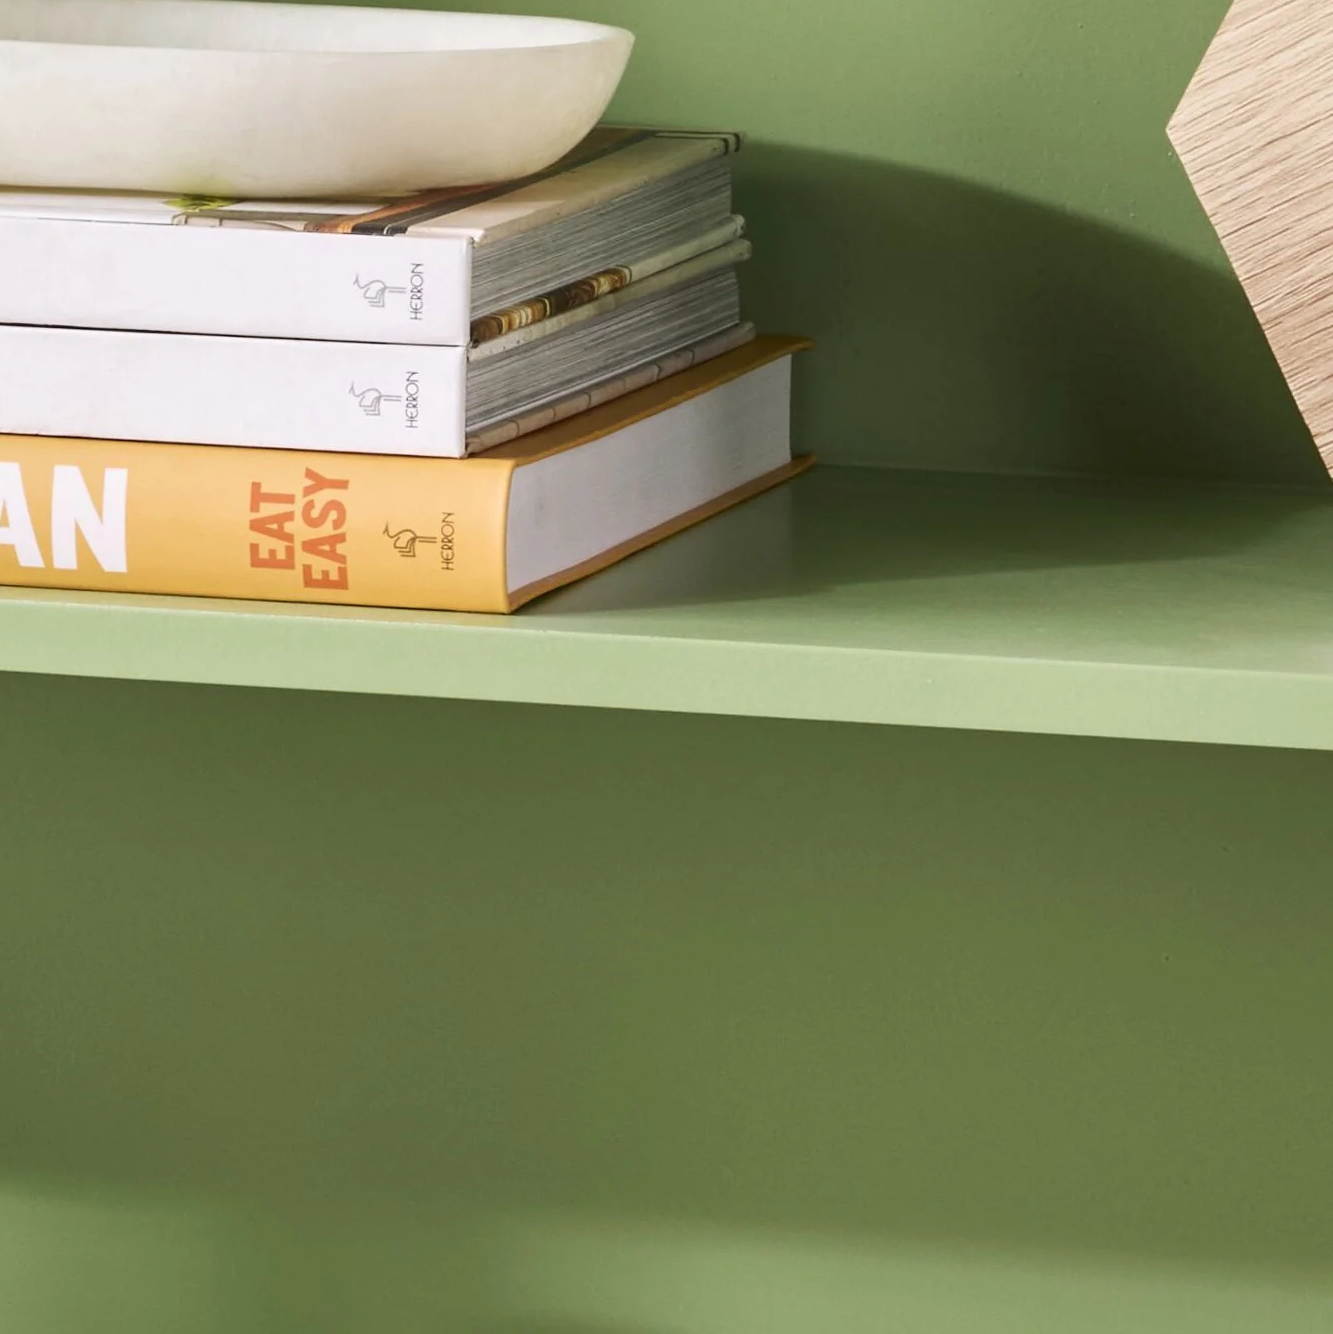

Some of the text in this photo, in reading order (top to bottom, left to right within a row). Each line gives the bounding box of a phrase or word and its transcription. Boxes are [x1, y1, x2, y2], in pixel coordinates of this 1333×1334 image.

[409, 262, 425, 321] HERRON
[404, 370, 420, 429] HERRON
[249, 481, 296, 570] EAT
[302, 467, 350, 591] EASY
[440, 511, 456, 572] HERRON
